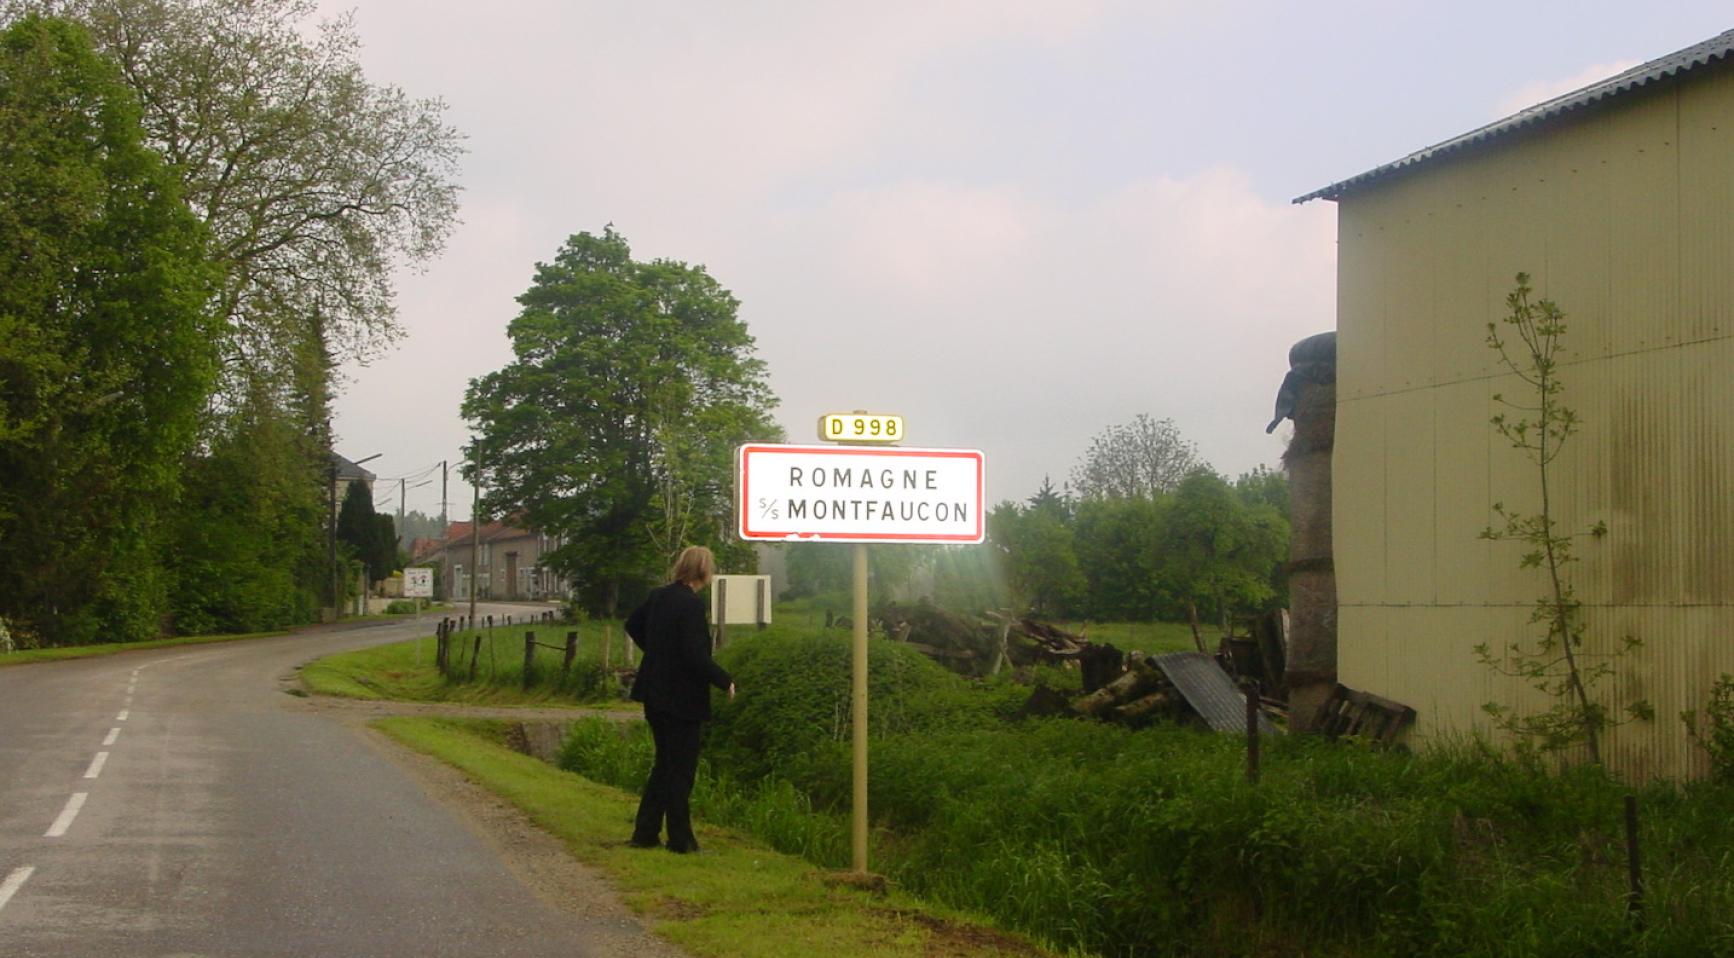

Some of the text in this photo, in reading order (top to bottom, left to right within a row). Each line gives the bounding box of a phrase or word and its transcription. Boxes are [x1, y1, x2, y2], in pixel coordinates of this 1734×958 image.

[831, 418, 897, 436] D 998
[789, 466, 938, 490] ROMAGNE
[787, 499, 968, 522] MONTFAUCON
